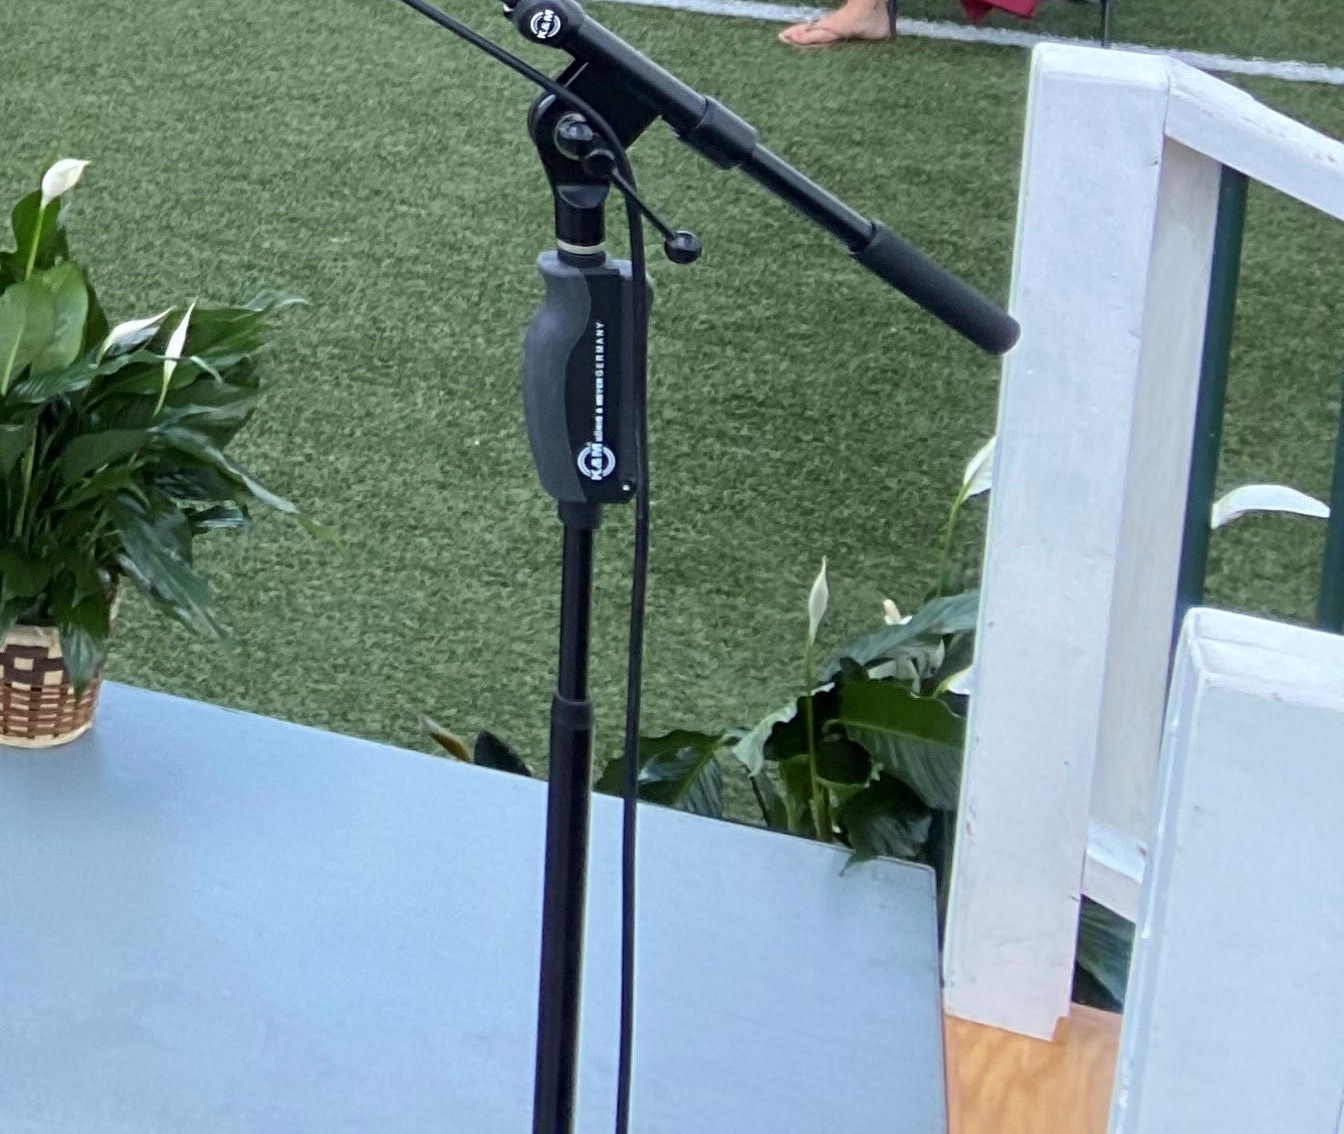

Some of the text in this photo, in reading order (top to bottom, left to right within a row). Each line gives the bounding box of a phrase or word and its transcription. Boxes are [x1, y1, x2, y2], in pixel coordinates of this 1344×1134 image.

[536, 9, 554, 39] K&M
[595, 322, 605, 376] GERMANY
[591, 442, 603, 481] K&M
